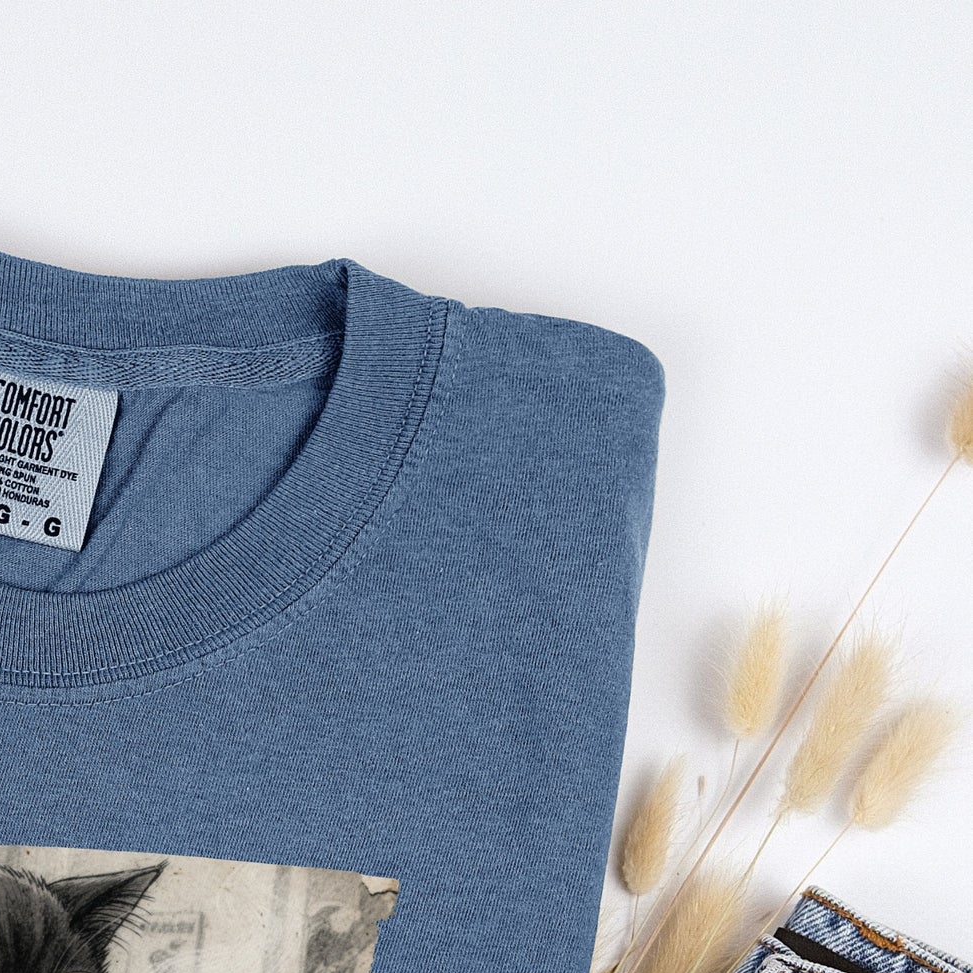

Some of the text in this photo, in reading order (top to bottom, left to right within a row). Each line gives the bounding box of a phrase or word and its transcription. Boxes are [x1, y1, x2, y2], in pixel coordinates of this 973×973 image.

[12, 469, 37, 484] SPUN
[16, 460, 60, 477] GARMENT
[59, 469, 79, 482] DYE
[4, 479, 40, 495] COTTON
[1, 489, 50, 509] HONDURAS
[43, 516, 62, 537] G
